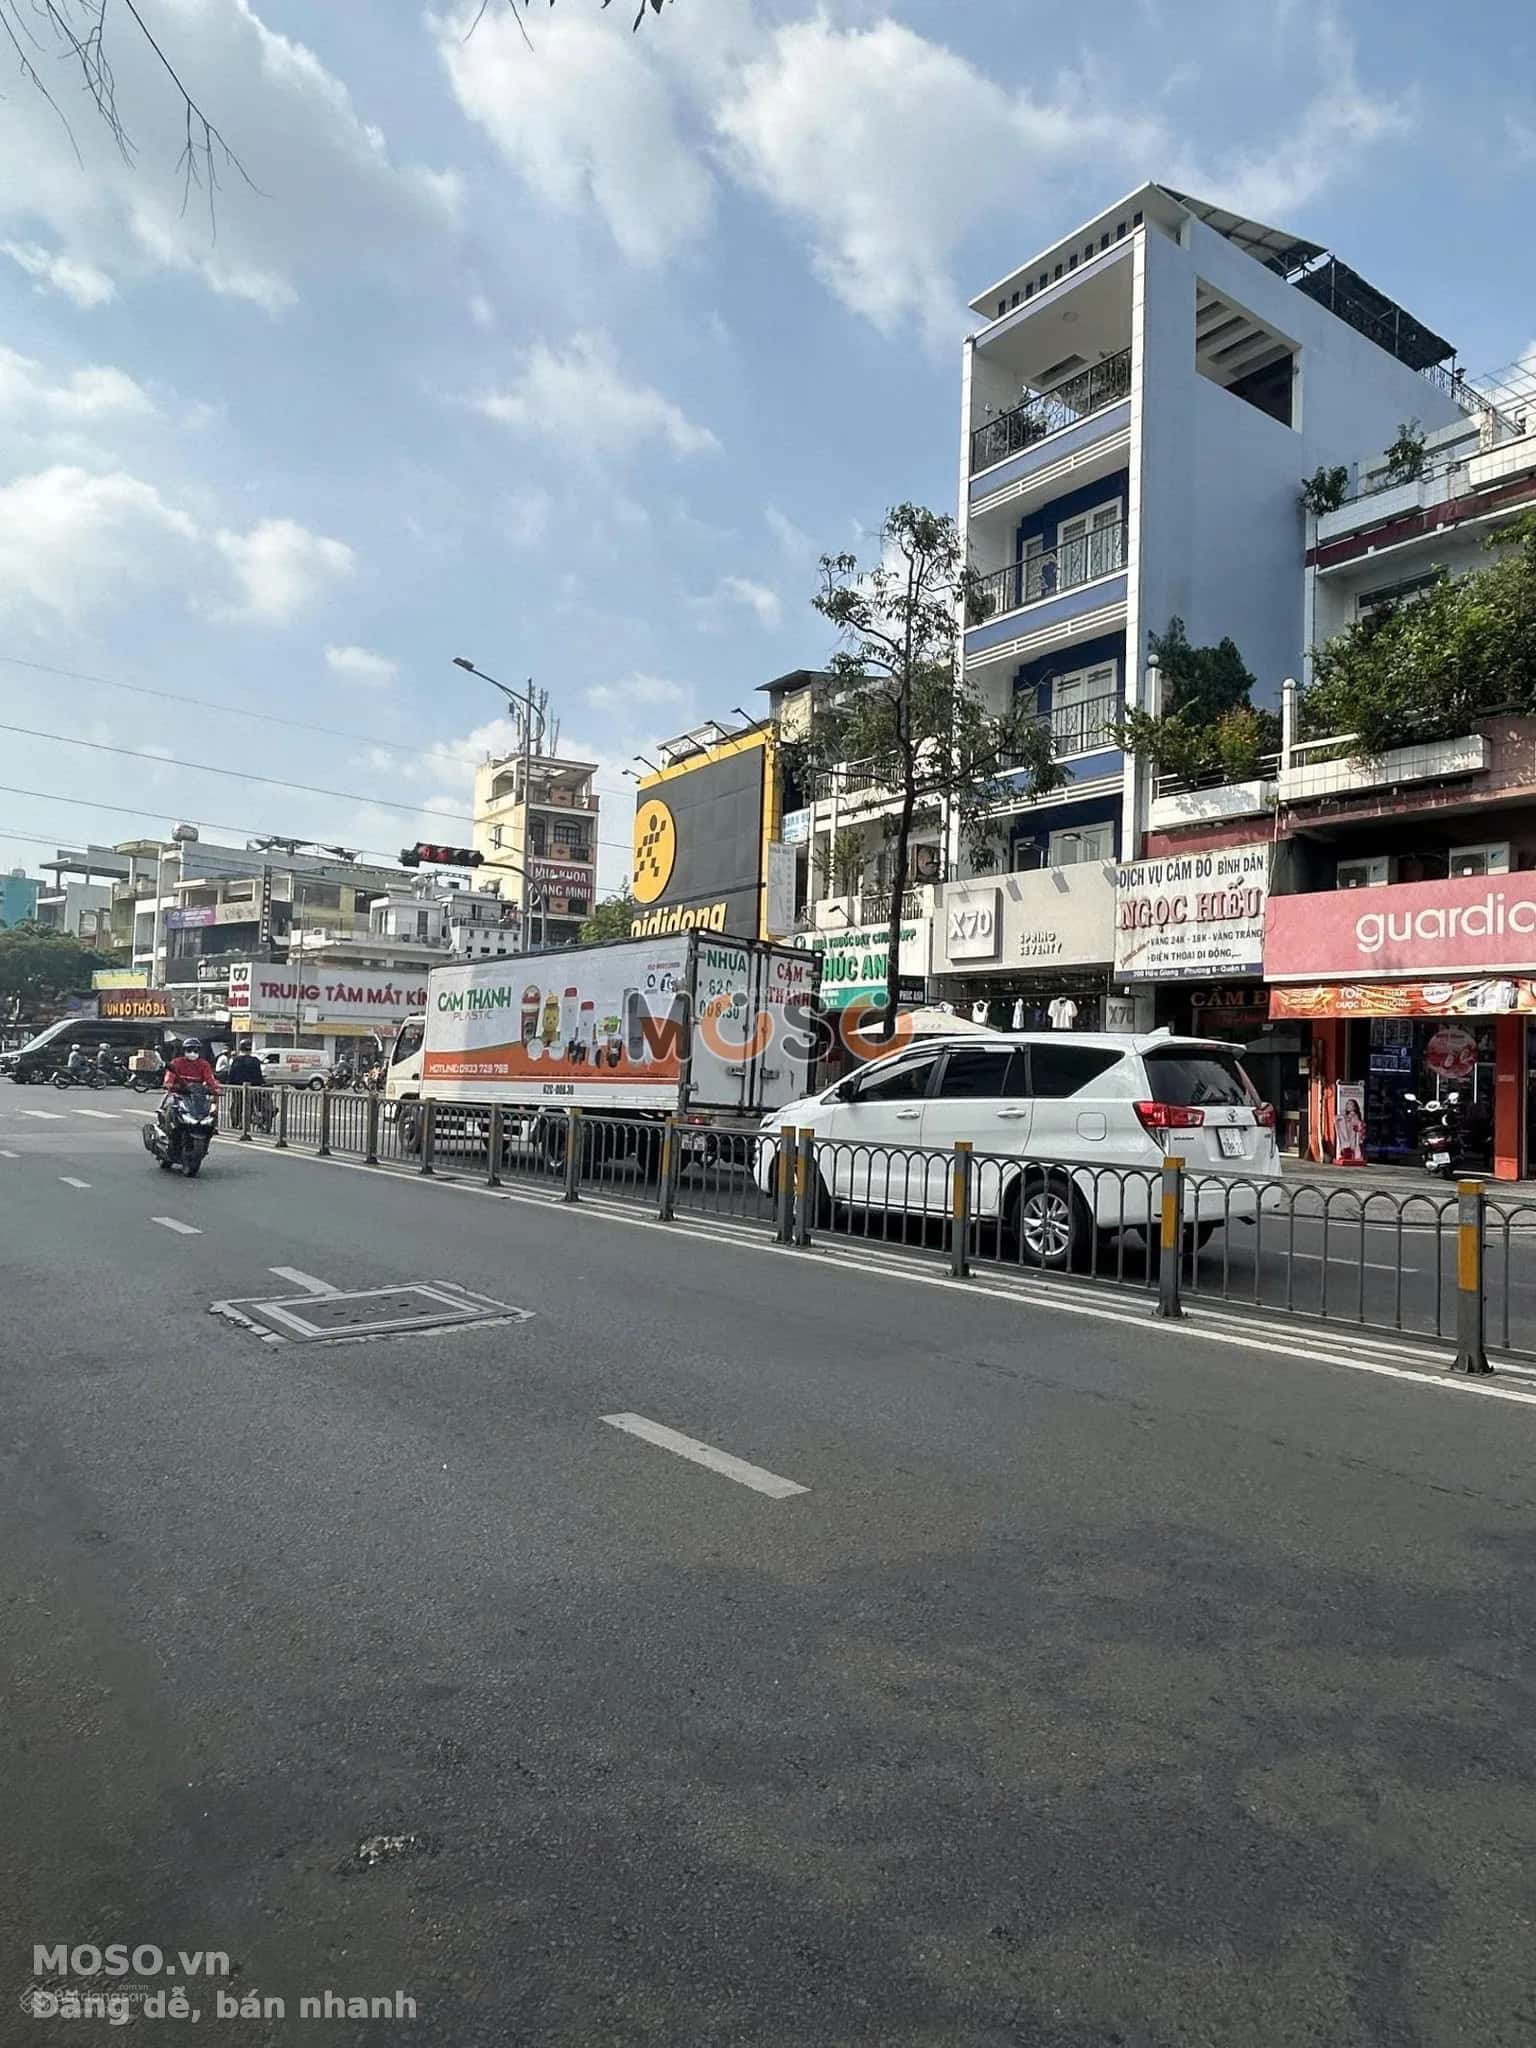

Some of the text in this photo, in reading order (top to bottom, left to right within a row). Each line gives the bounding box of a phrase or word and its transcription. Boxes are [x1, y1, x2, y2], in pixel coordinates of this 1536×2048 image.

[1119, 867, 1145, 891] DỊCH
[1148, 864, 1163, 887] VỤ
[1217, 857, 1240, 875] BÌNH
[1243, 852, 1264, 872] DÂN
[1119, 876, 1263, 934] NGỌC HIẾU
[950, 909, 992, 941] X70
[707, 949, 747, 975] NHỰA
[823, 951, 887, 982] HÚC AN
[259, 982, 320, 1001] TRUNG
[326, 982, 362, 1003] TÂM
[367, 982, 402, 1005] MẮT
